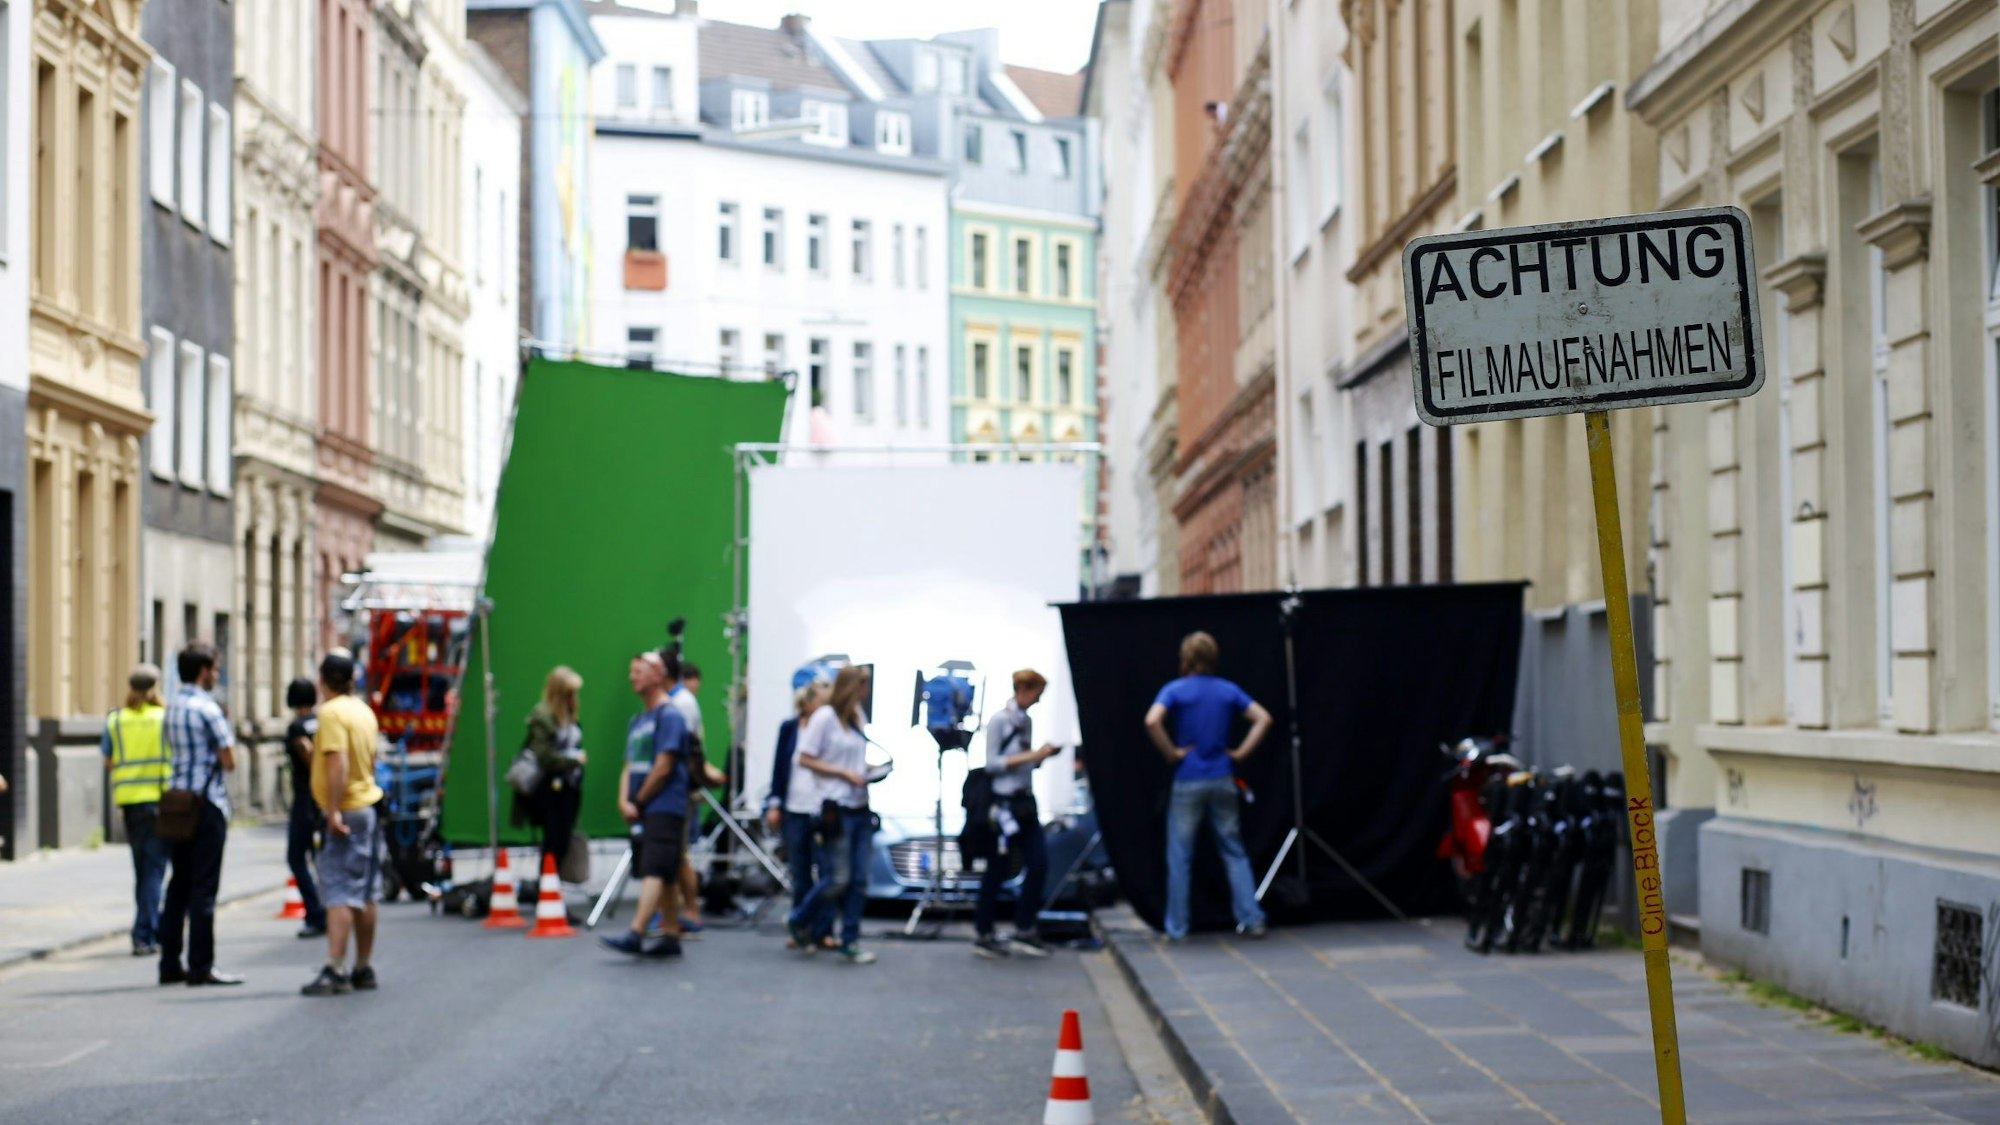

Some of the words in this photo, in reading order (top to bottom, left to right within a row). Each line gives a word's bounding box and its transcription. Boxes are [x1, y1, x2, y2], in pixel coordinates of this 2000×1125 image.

[1425, 226, 1725, 305] ACHTUNG
[1437, 321, 1732, 400] FILMAUFNAHMEN
[1628, 797, 1657, 871] Block
[1641, 876, 1664, 935] Cine
